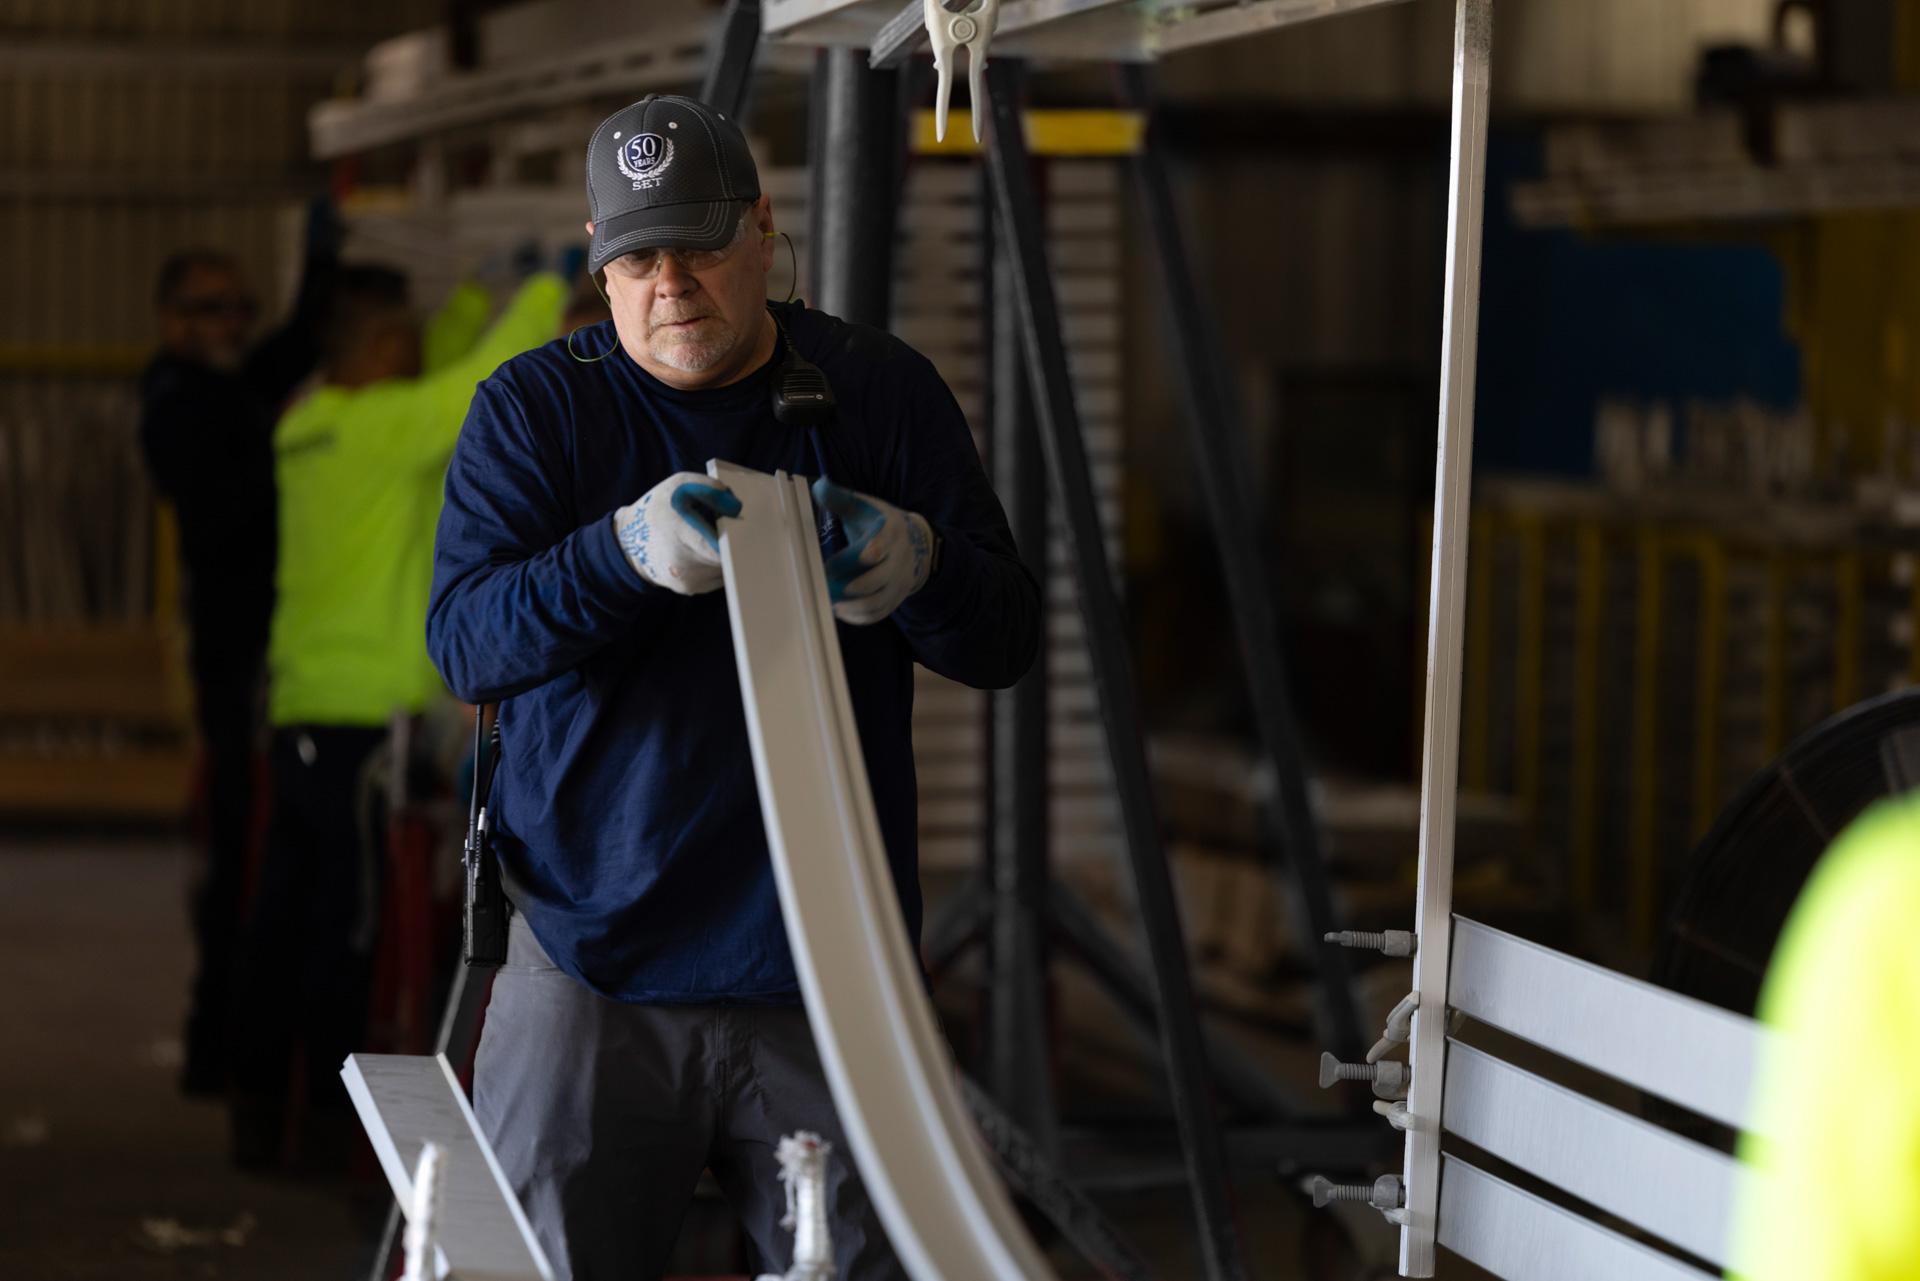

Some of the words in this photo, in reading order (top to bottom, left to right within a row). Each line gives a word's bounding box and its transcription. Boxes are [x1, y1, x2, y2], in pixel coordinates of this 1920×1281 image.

[631, 137, 656, 160] 50
[633, 157, 656, 168] YEARS
[632, 177, 663, 191] SET
